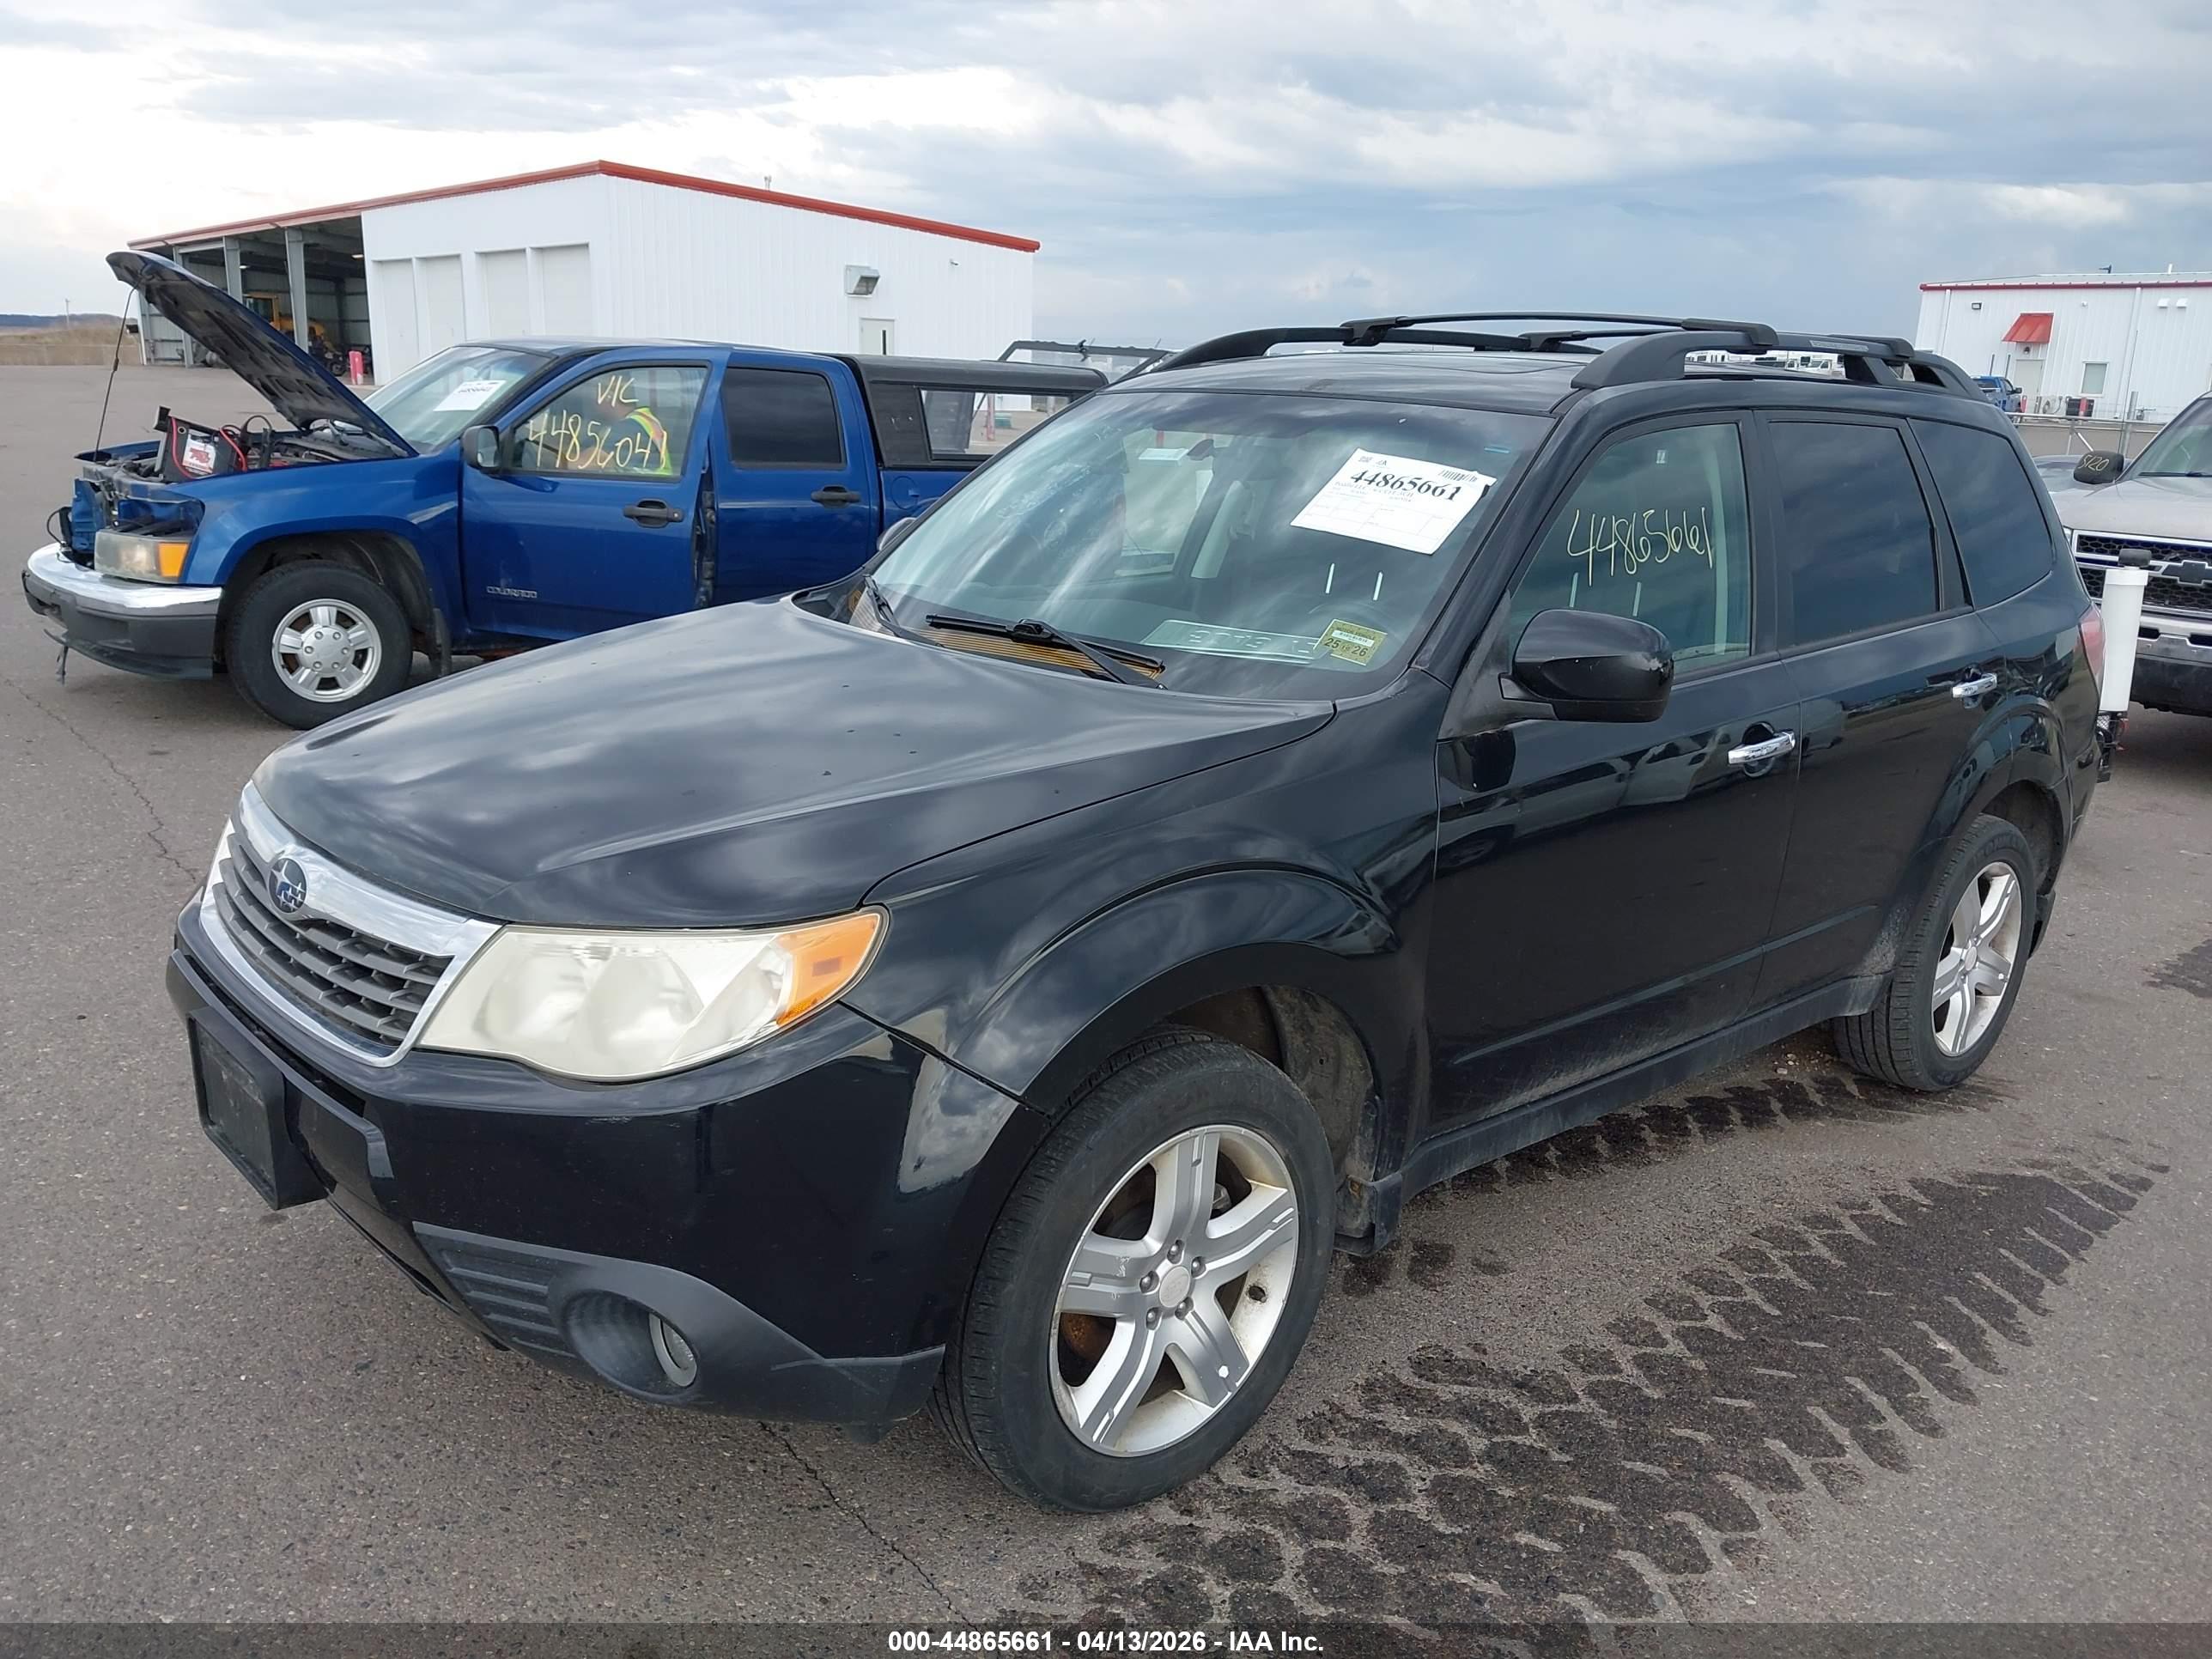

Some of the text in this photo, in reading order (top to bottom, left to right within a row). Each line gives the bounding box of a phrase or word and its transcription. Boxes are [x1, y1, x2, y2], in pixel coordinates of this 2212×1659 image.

[528, 410, 667, 470] 44856041
[1350, 469, 1462, 501] 44865661
[1567, 507, 1713, 586] 44865661
[1323, 637, 1341, 649] 25
[1351, 645, 1369, 657] 26
